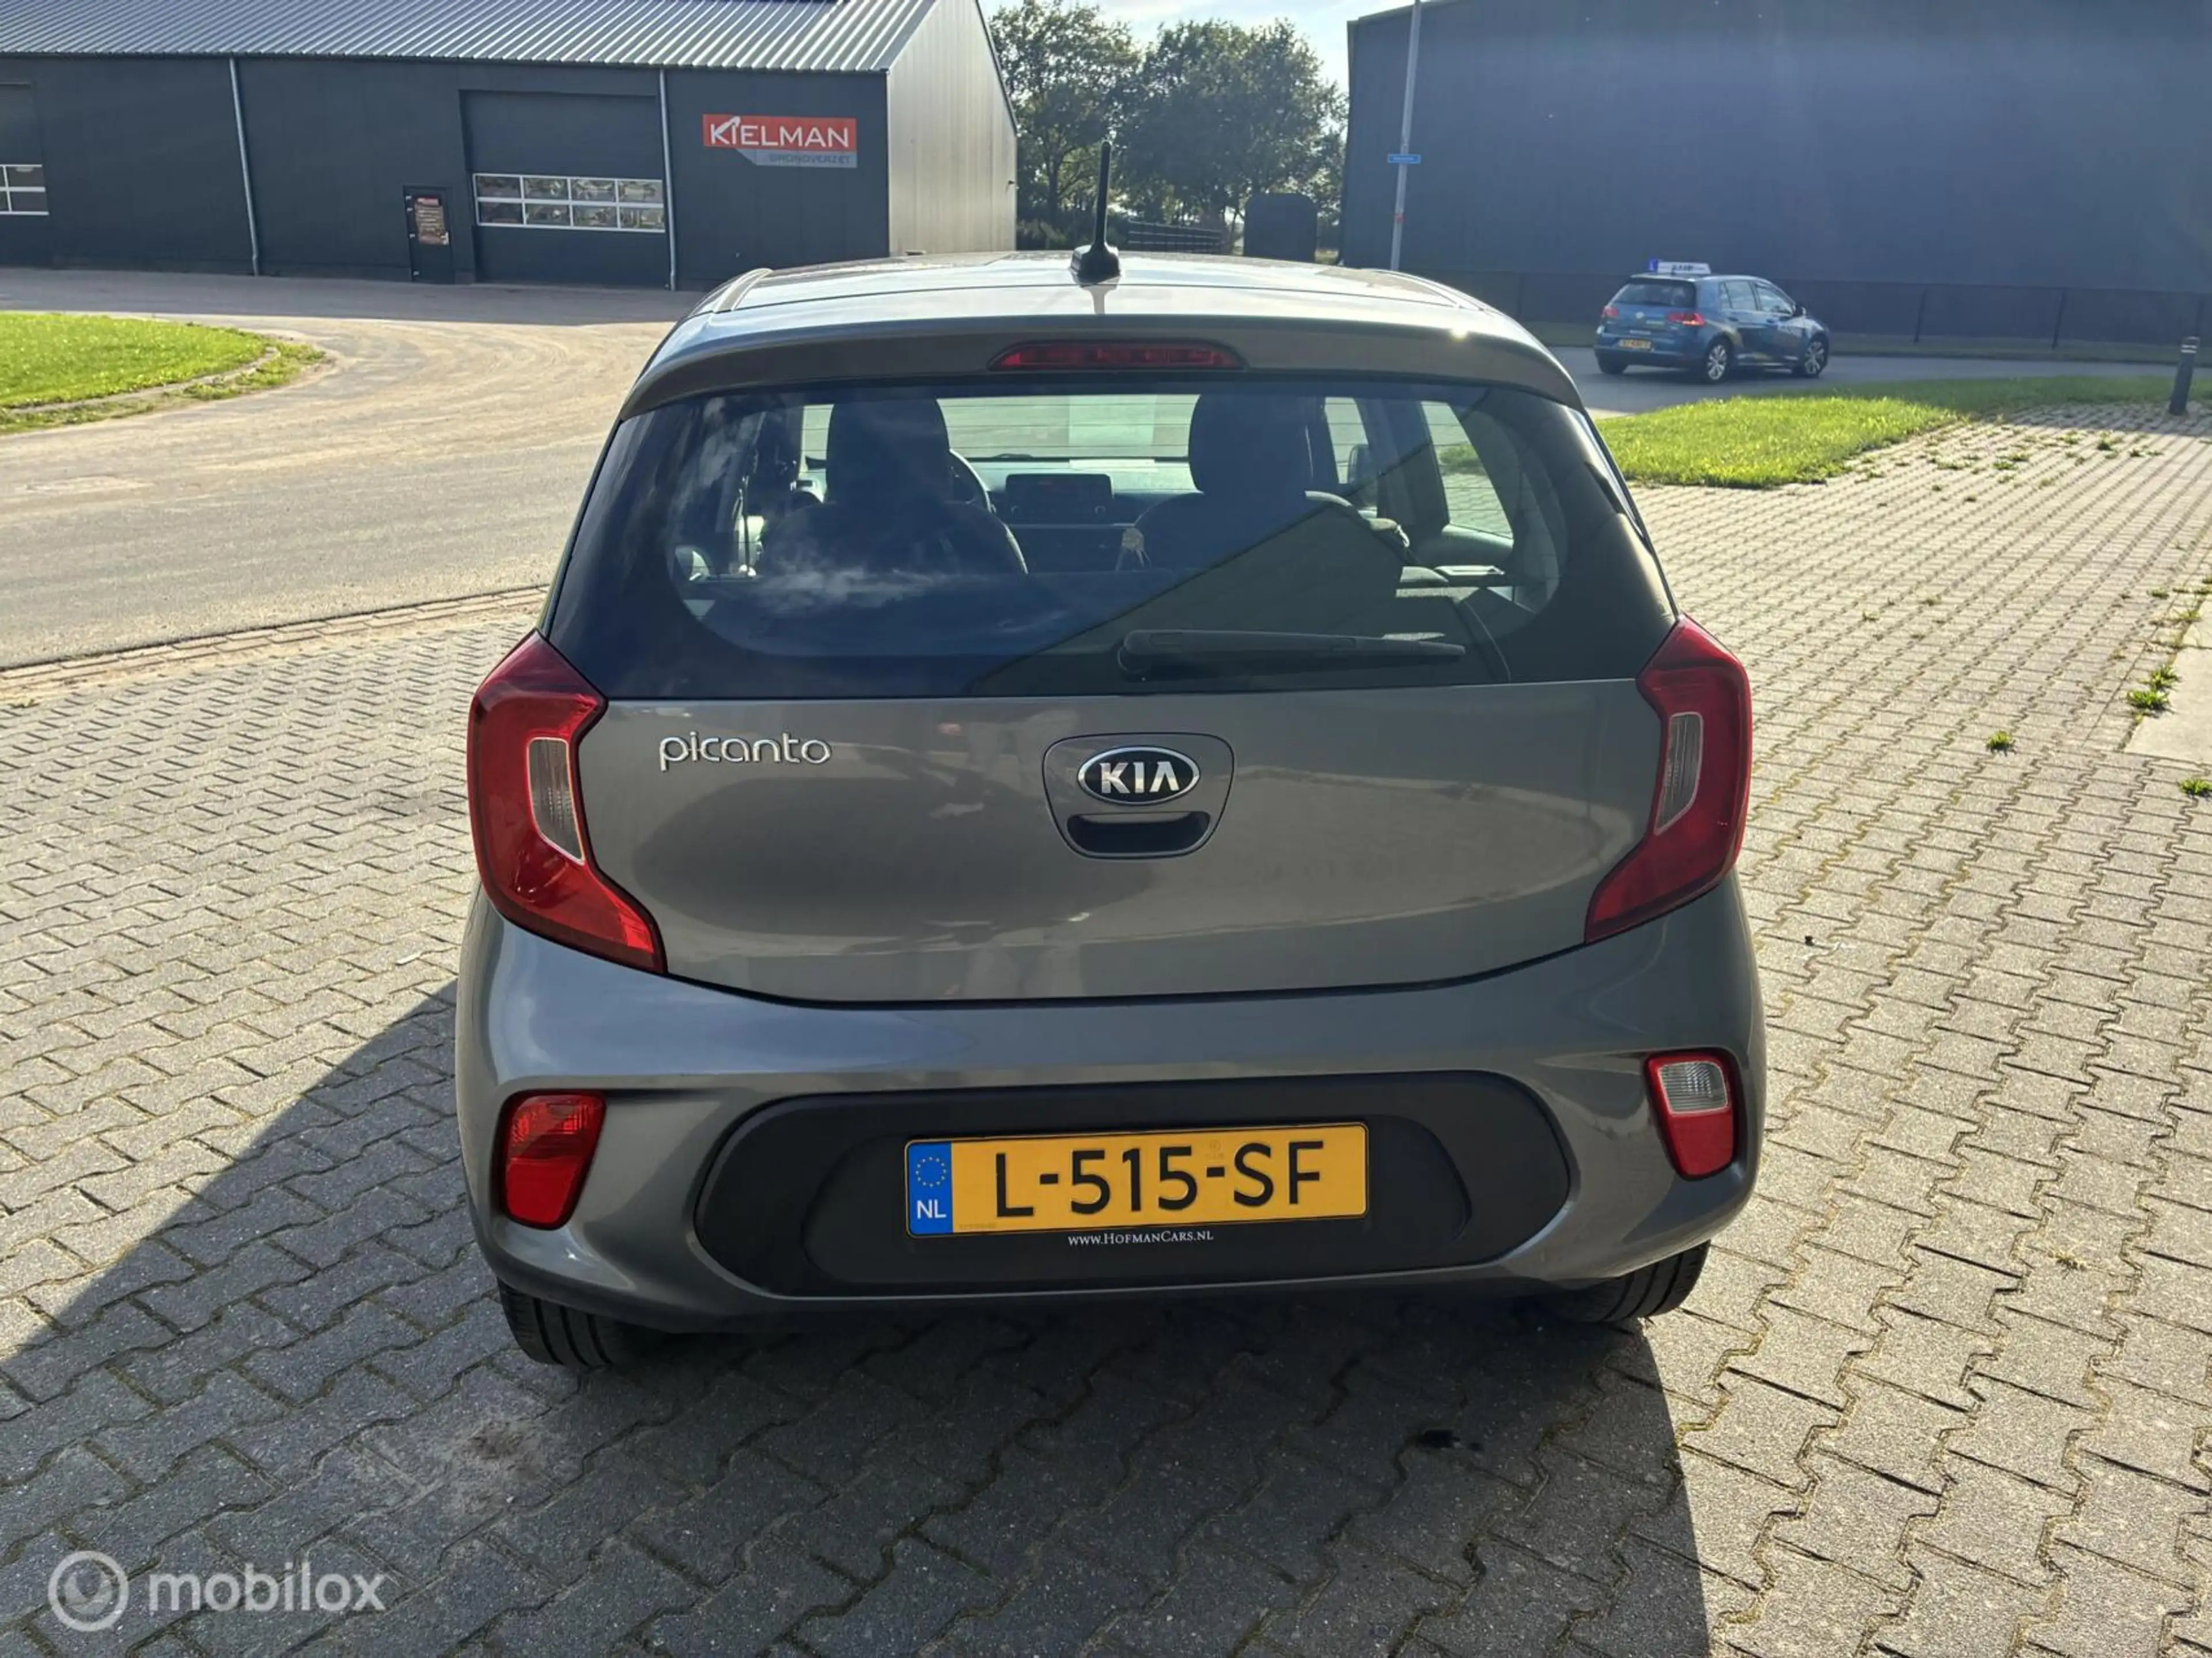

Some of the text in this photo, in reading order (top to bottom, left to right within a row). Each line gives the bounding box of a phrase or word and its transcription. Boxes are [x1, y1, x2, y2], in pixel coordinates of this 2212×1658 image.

[710, 116, 849, 147] KIELMAN
[660, 731, 831, 771] picanto
[1099, 761, 1180, 794] KIA
[995, 1140, 1324, 1217] L-515-SF
[916, 1198, 947, 1219] NL
